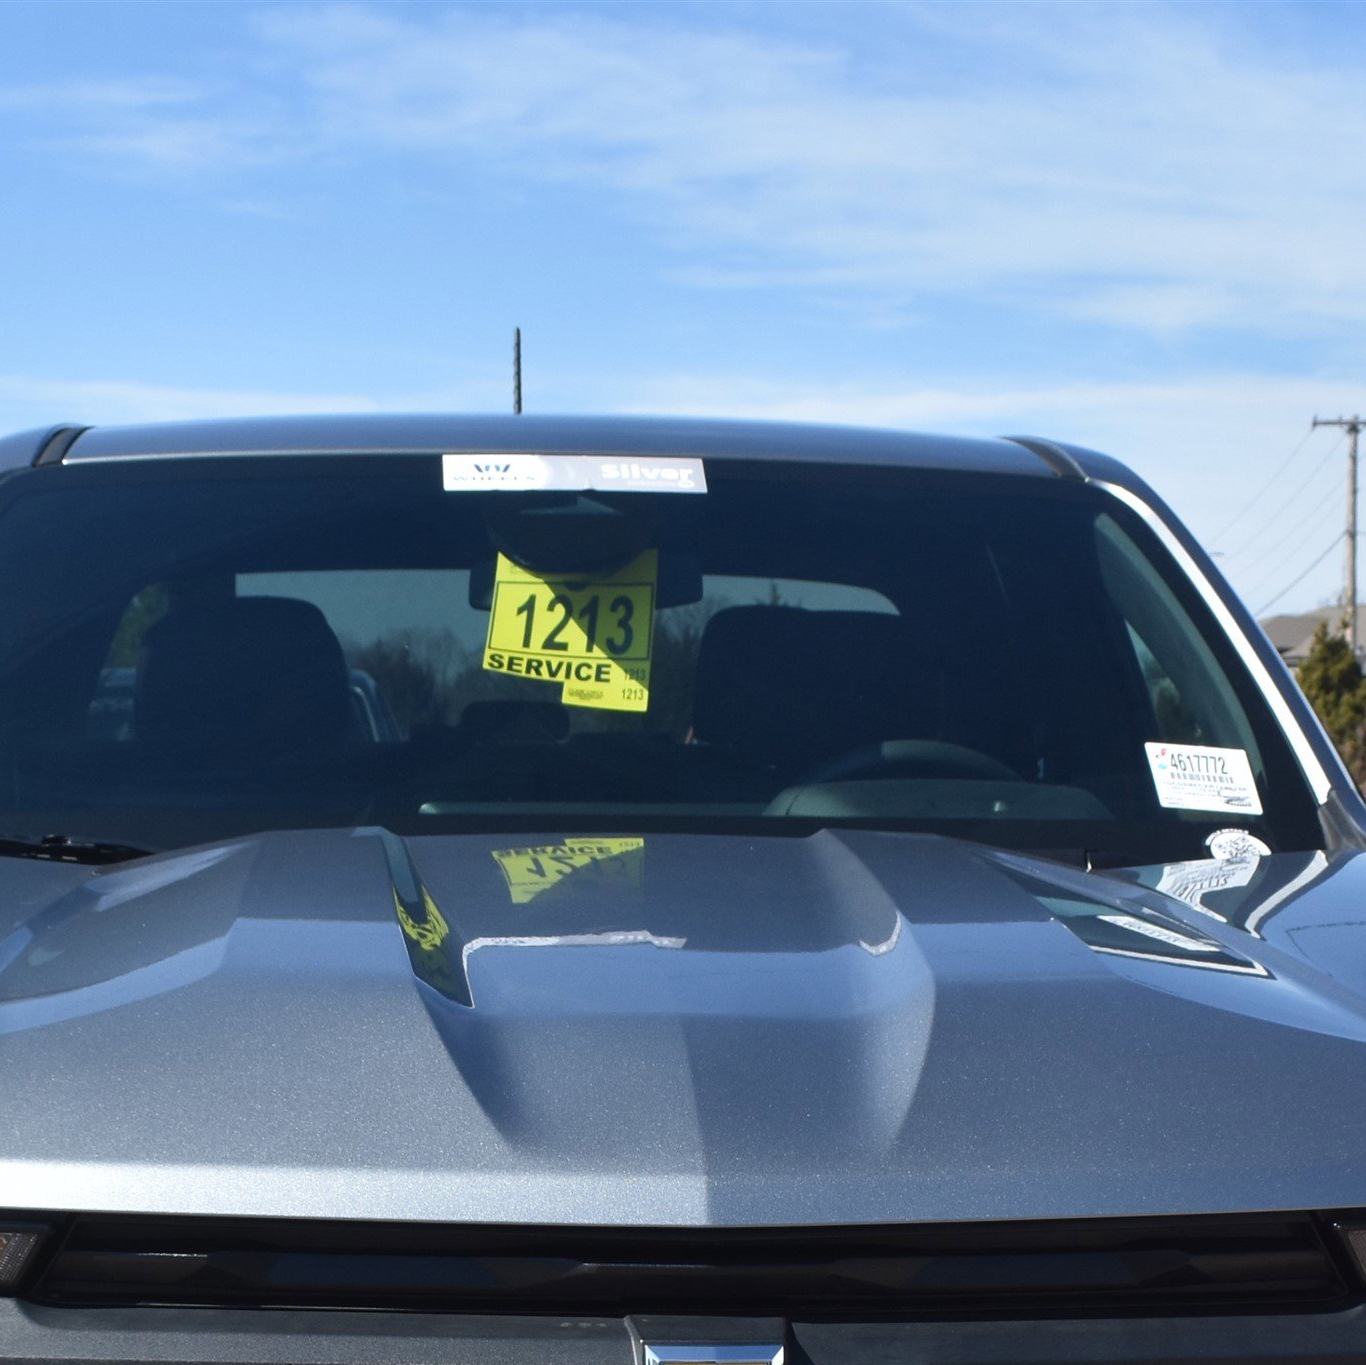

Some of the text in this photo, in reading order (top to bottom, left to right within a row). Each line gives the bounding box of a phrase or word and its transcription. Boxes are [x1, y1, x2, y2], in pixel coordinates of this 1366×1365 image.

[600, 464, 694, 482] Silver
[515, 593, 635, 656] 1213
[487, 653, 612, 683] SERVICE
[621, 688, 644, 701] 1213
[1170, 753, 1229, 775] 4617772
